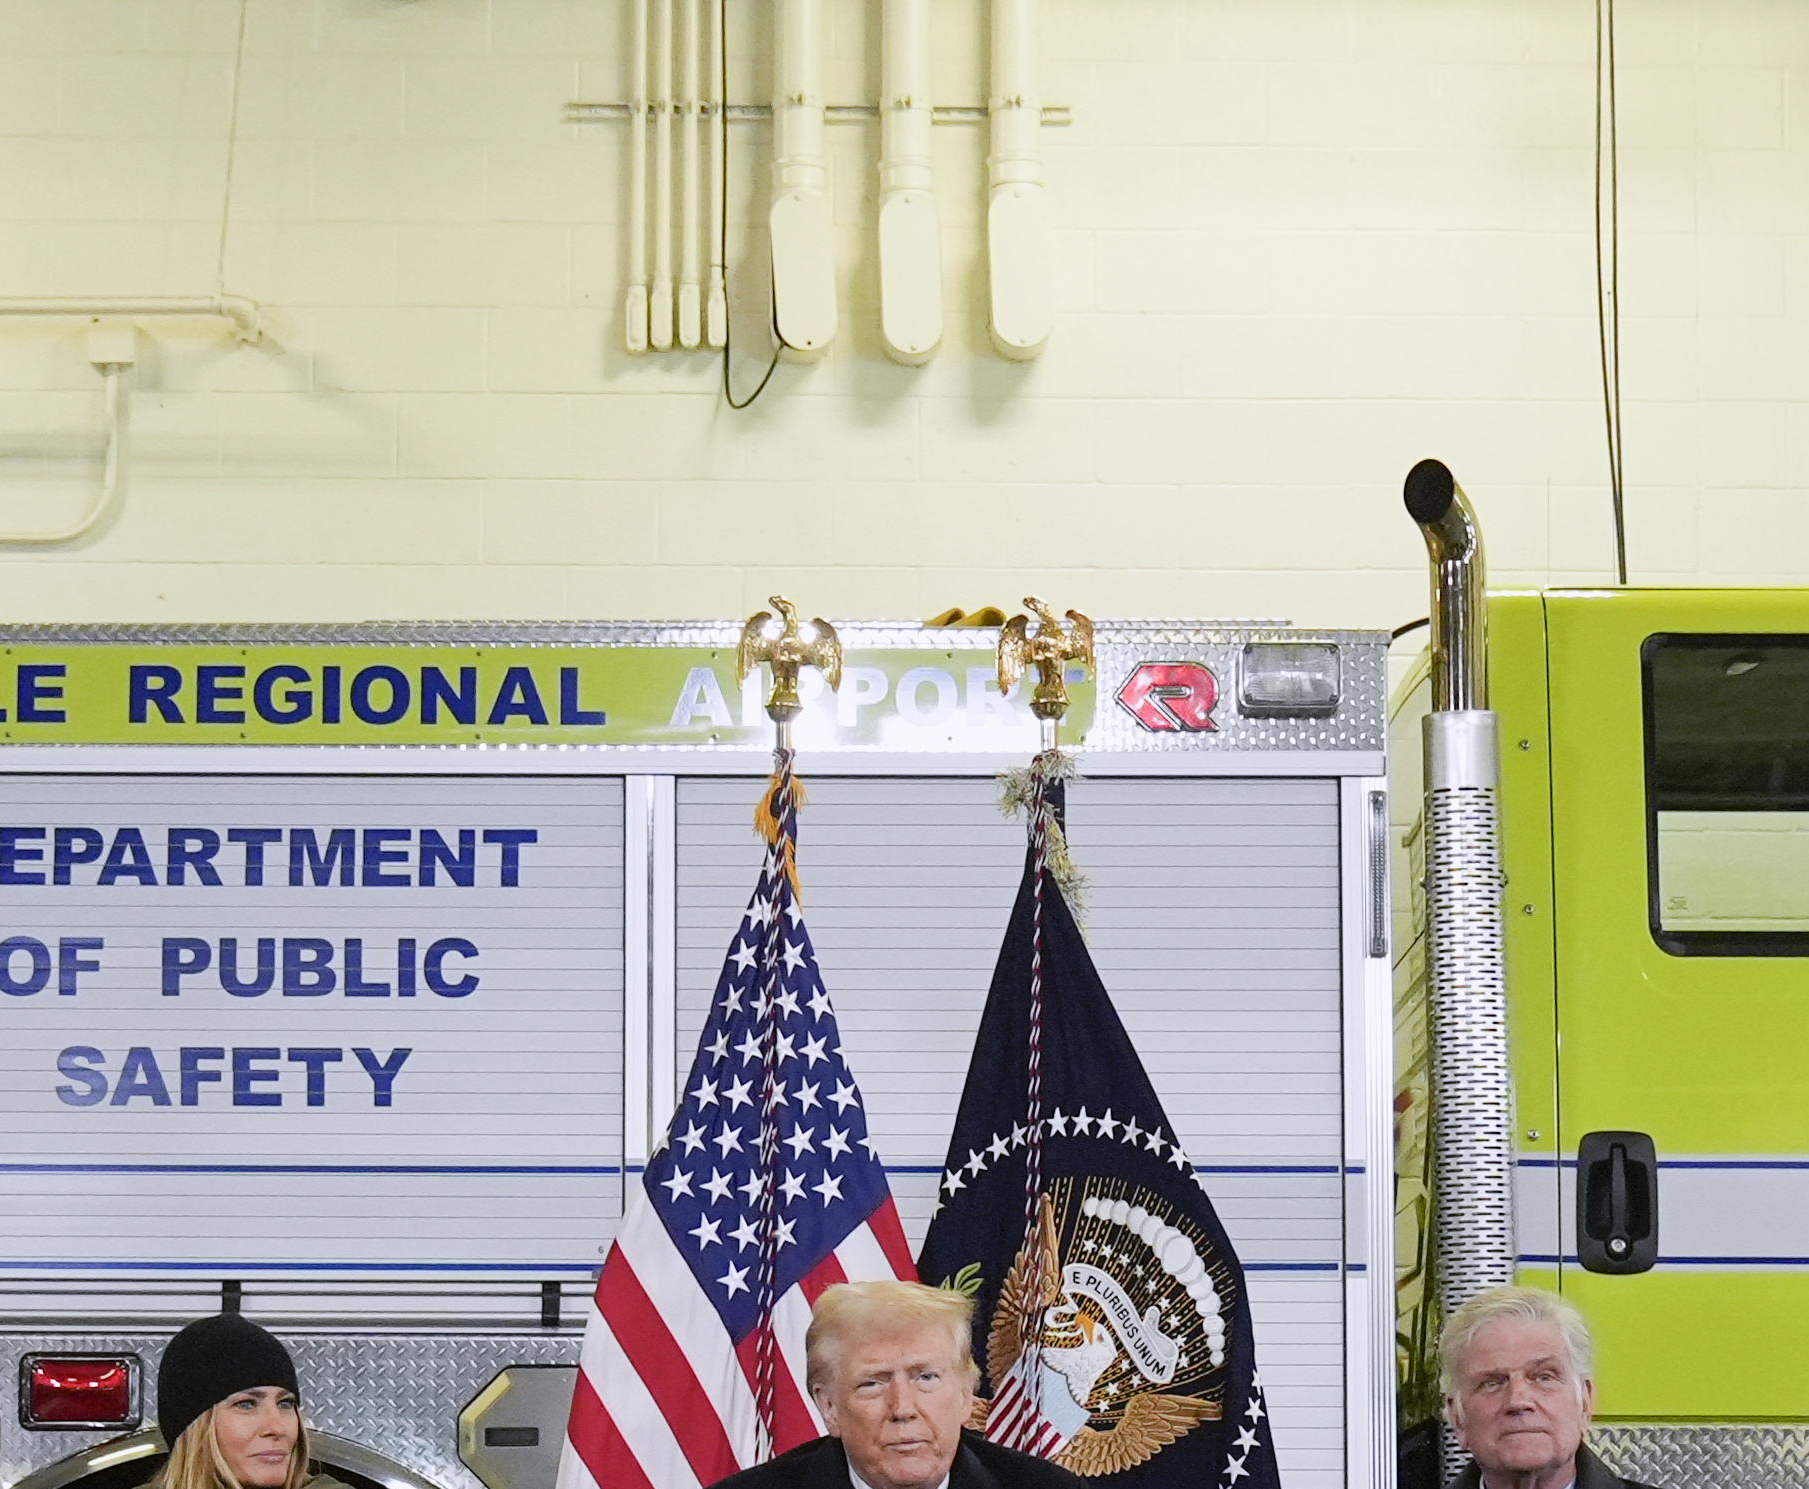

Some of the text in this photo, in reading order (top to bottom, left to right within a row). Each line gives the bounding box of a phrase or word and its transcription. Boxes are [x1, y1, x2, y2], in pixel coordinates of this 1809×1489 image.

[129, 666, 607, 726] REGIONAL
[669, 667, 1084, 727] AIRPOR
[161, 937, 480, 999] PUBLIC
[55, 1045, 413, 1107] SAFETY
[1072, 1271, 1166, 1377] E PLURIBUS UNUM
